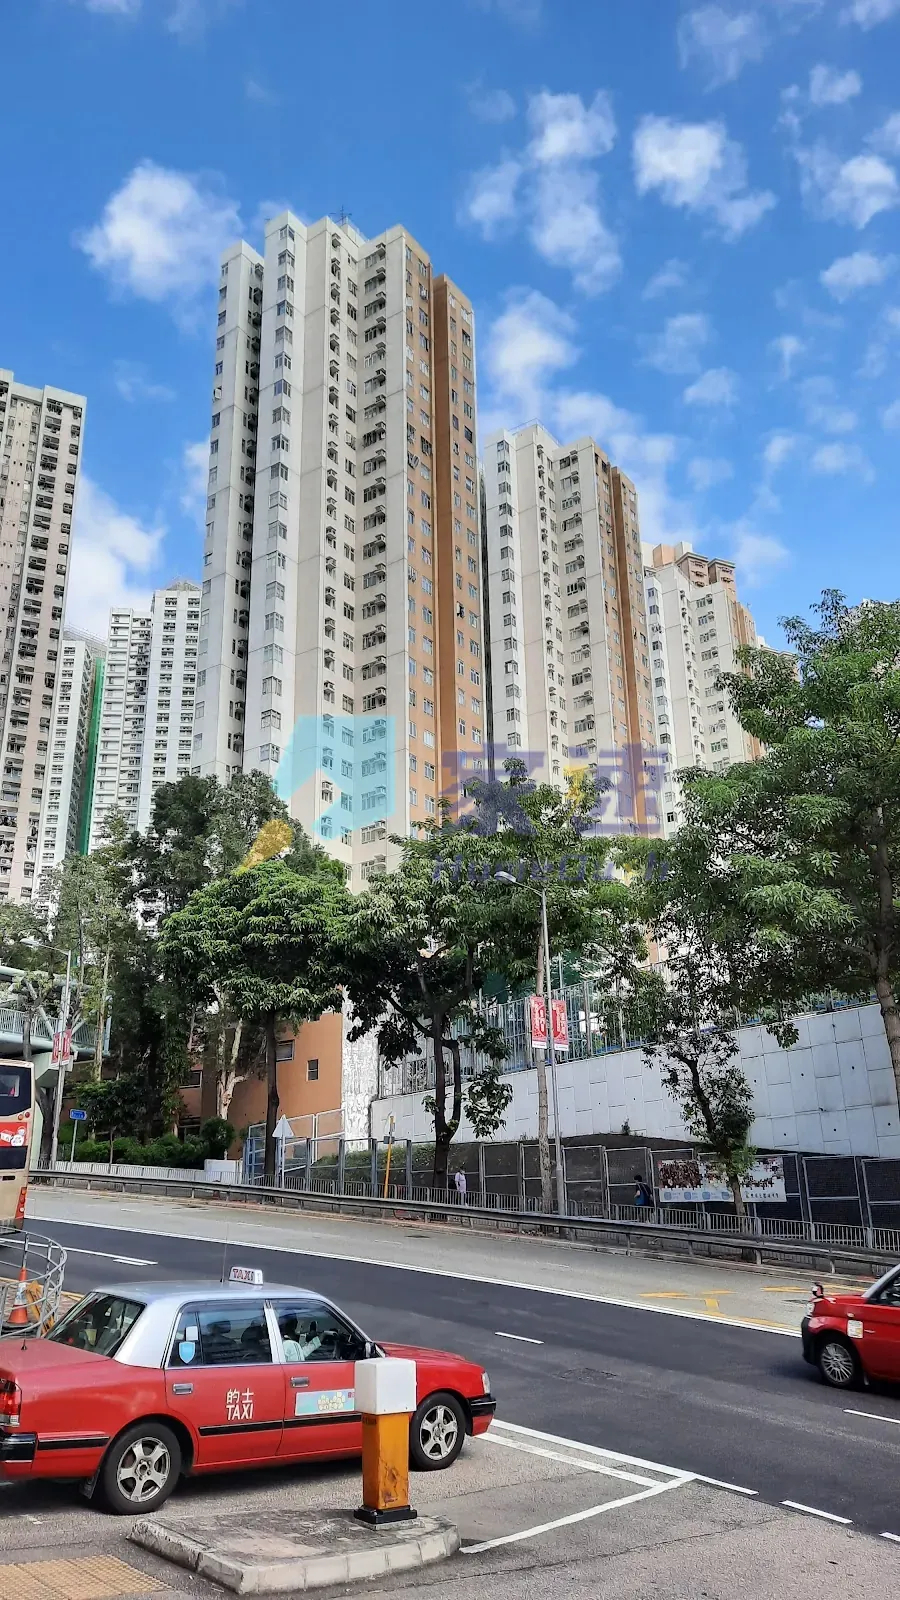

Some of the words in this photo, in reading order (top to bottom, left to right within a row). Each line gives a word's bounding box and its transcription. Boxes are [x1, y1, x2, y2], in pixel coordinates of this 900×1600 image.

[232, 1268, 255, 1281] TAXI
[226, 1387, 254, 1404] 的士
[226, 1403, 254, 1421] TAXI
